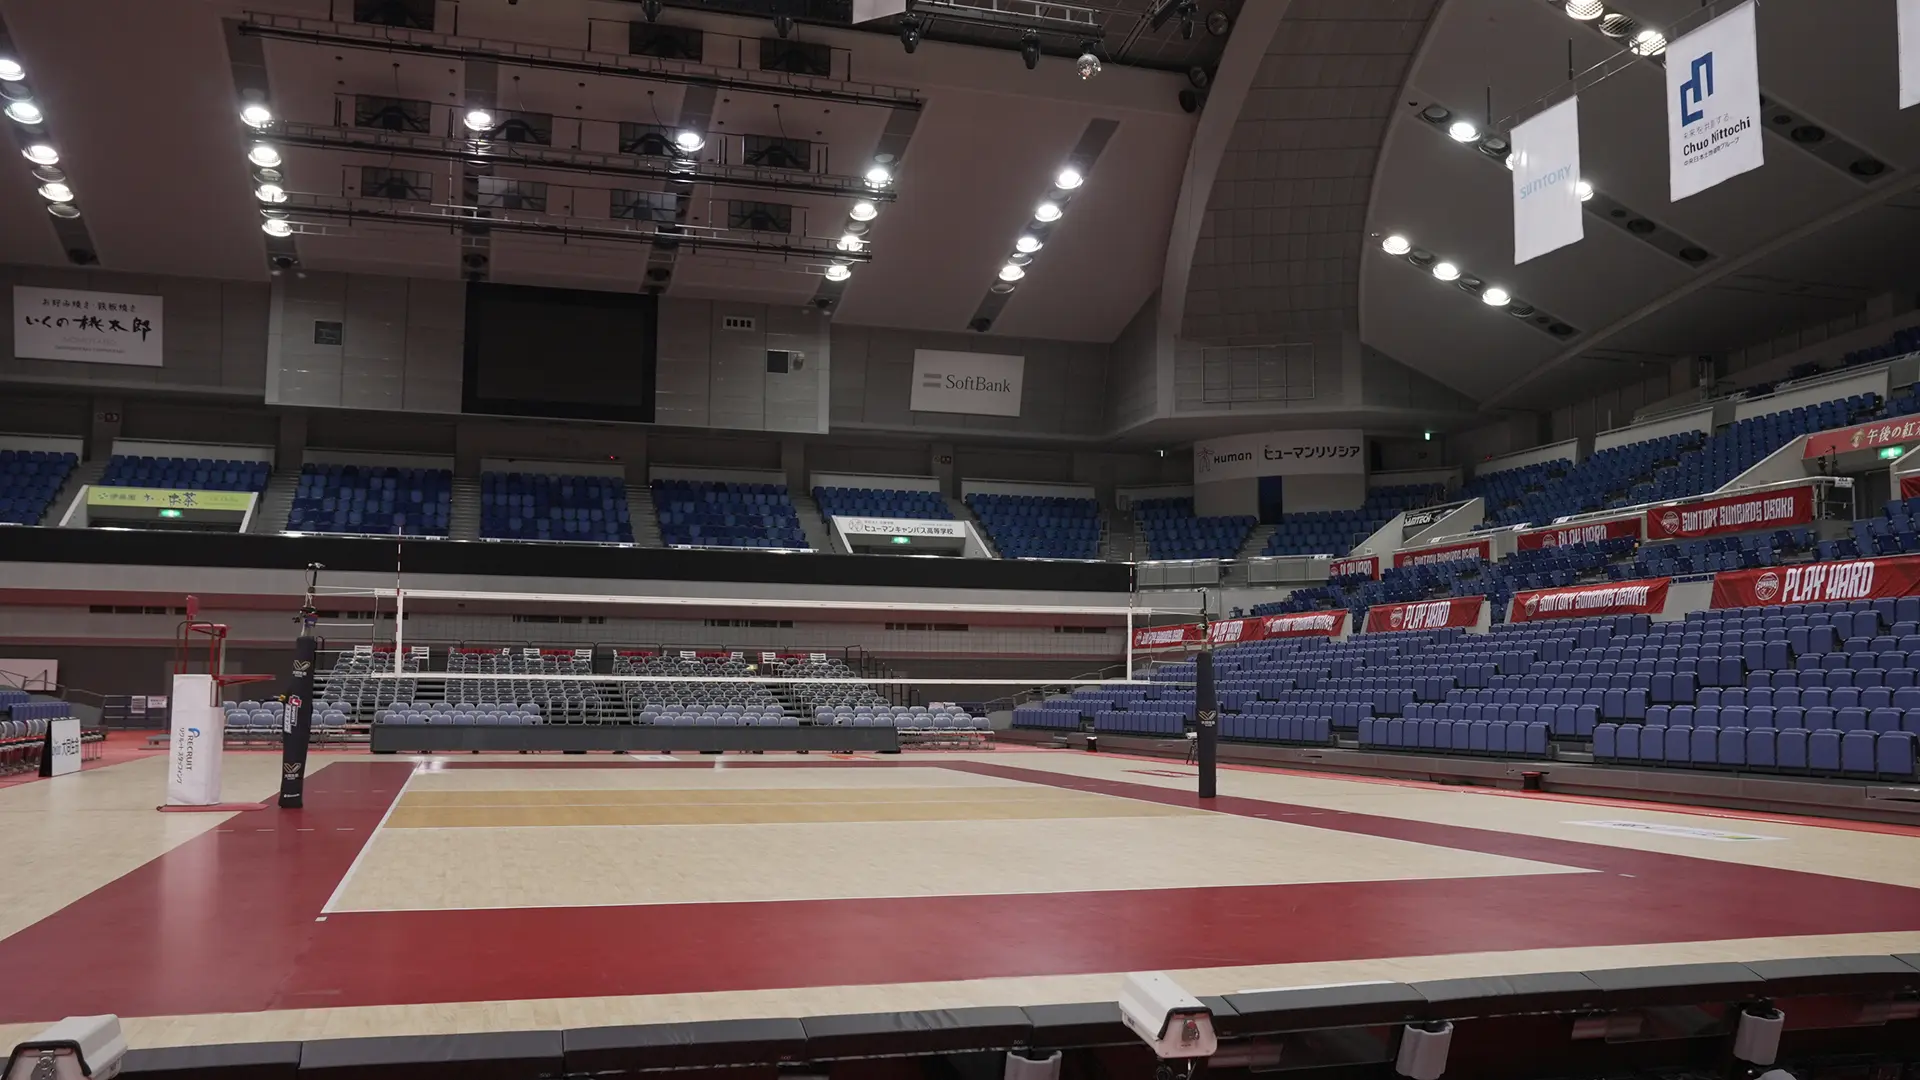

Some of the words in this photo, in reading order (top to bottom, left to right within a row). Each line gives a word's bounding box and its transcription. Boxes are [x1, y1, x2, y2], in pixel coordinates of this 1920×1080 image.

[1683, 138, 1709, 156] Chuo
[1711, 117, 1751, 144] Nittochi
[1520, 164, 1571, 199] SUNTORY
[945, 374, 1011, 393] SoftBank
[1264, 444, 1360, 460] ヒューマンリソシア
[864, 525, 954, 535] ヒューマンキャンパス高等学校
[1682, 507, 1719, 531] SUNTORY
[1719, 500, 1762, 526] SUNBIRDS
[1763, 496, 1794, 520] OSAKA
[1782, 565, 1827, 602] PLAY
[1825, 561, 1875, 600] HARD
[1403, 603, 1428, 629] PLAY
[1424, 601, 1451, 628] HARD
[186, 735, 194, 771] RECRUIT
